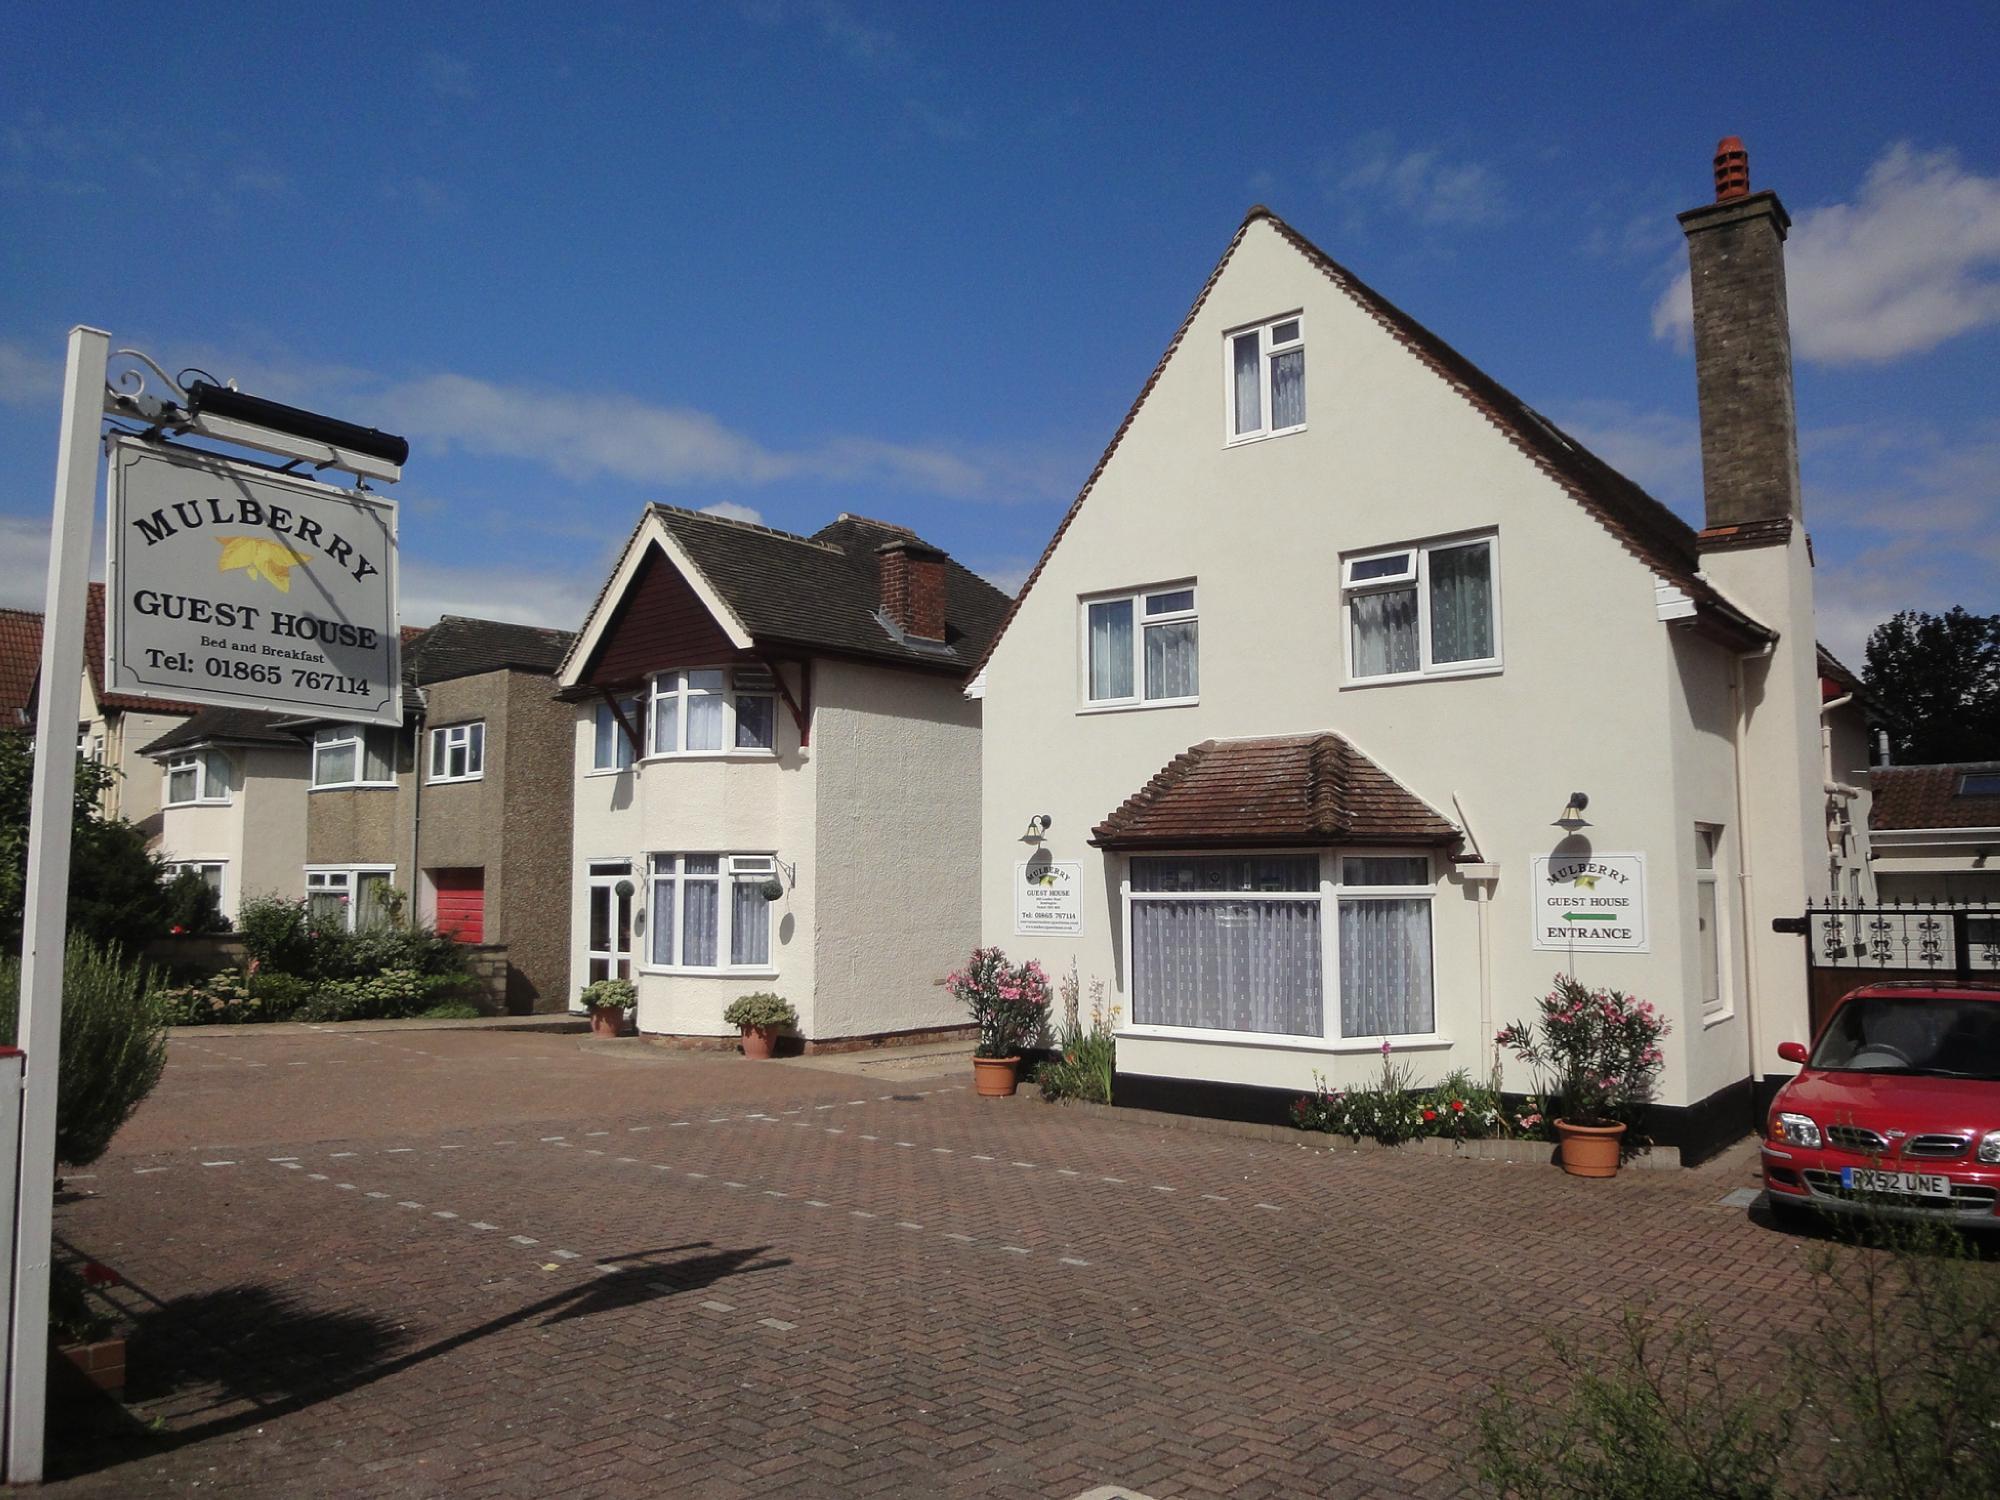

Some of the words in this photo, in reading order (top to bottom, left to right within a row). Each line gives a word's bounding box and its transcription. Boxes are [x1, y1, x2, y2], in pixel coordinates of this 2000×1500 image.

[132, 498, 378, 583] MULBERRY
[133, 590, 259, 630] GUEST
[270, 611, 378, 650] HOUSE
[200, 636, 227, 649] Bed
[231, 641, 257, 654] and
[262, 645, 325, 664] Breakfast
[146, 648, 194, 673] Tel:
[205, 657, 282, 685] 01865
[291, 669, 371, 696] 767114
[1027, 866, 1071, 881] MULBERRY
[1546, 863, 1630, 887] MULBERRY
[1547, 897, 1586, 906] GUEST
[1590, 898, 1630, 907] HOUSE
[1547, 927, 1632, 939] ENTRANCE
[1906, 1175, 1943, 1192] UNE
